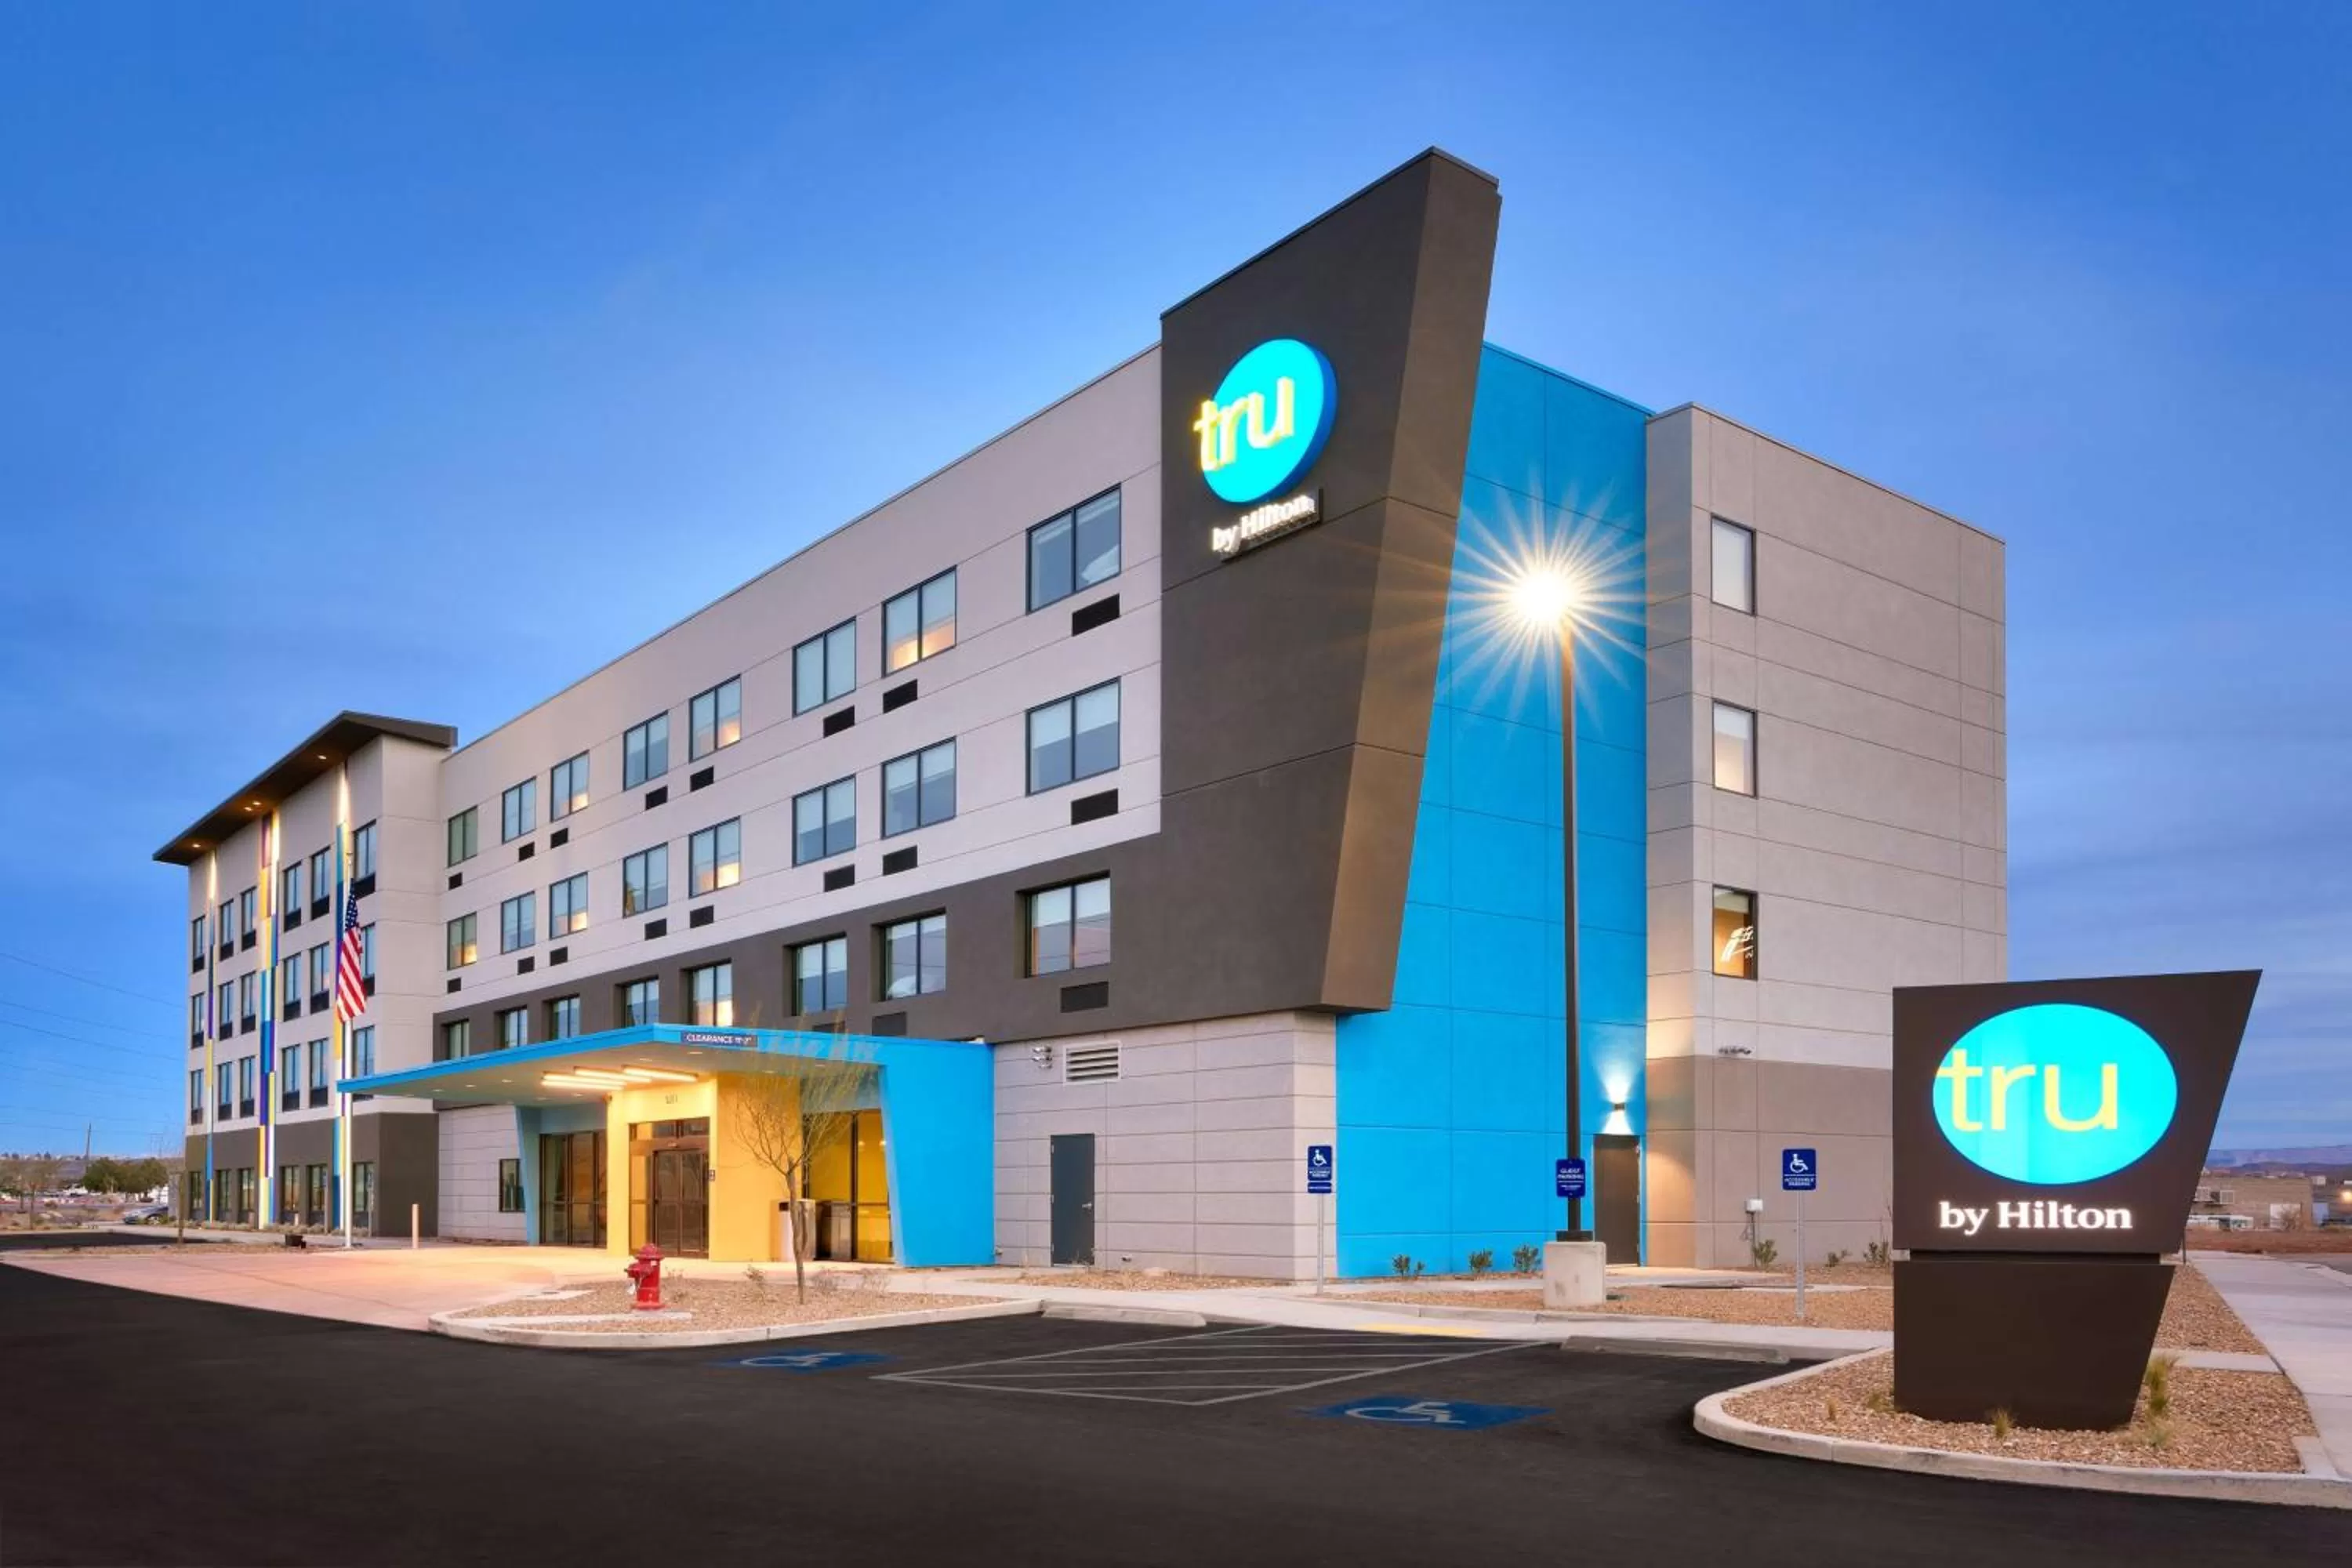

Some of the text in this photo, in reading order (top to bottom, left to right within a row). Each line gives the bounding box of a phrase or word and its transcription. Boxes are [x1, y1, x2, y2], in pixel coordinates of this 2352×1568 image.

[1192, 376, 1294, 472] tru
[1212, 495, 1316, 553] by Hilton
[686, 1033, 733, 1044] CLEARANCE
[1935, 1047, 2119, 1132] tru
[1938, 1201, 2132, 1236] by Hilton
